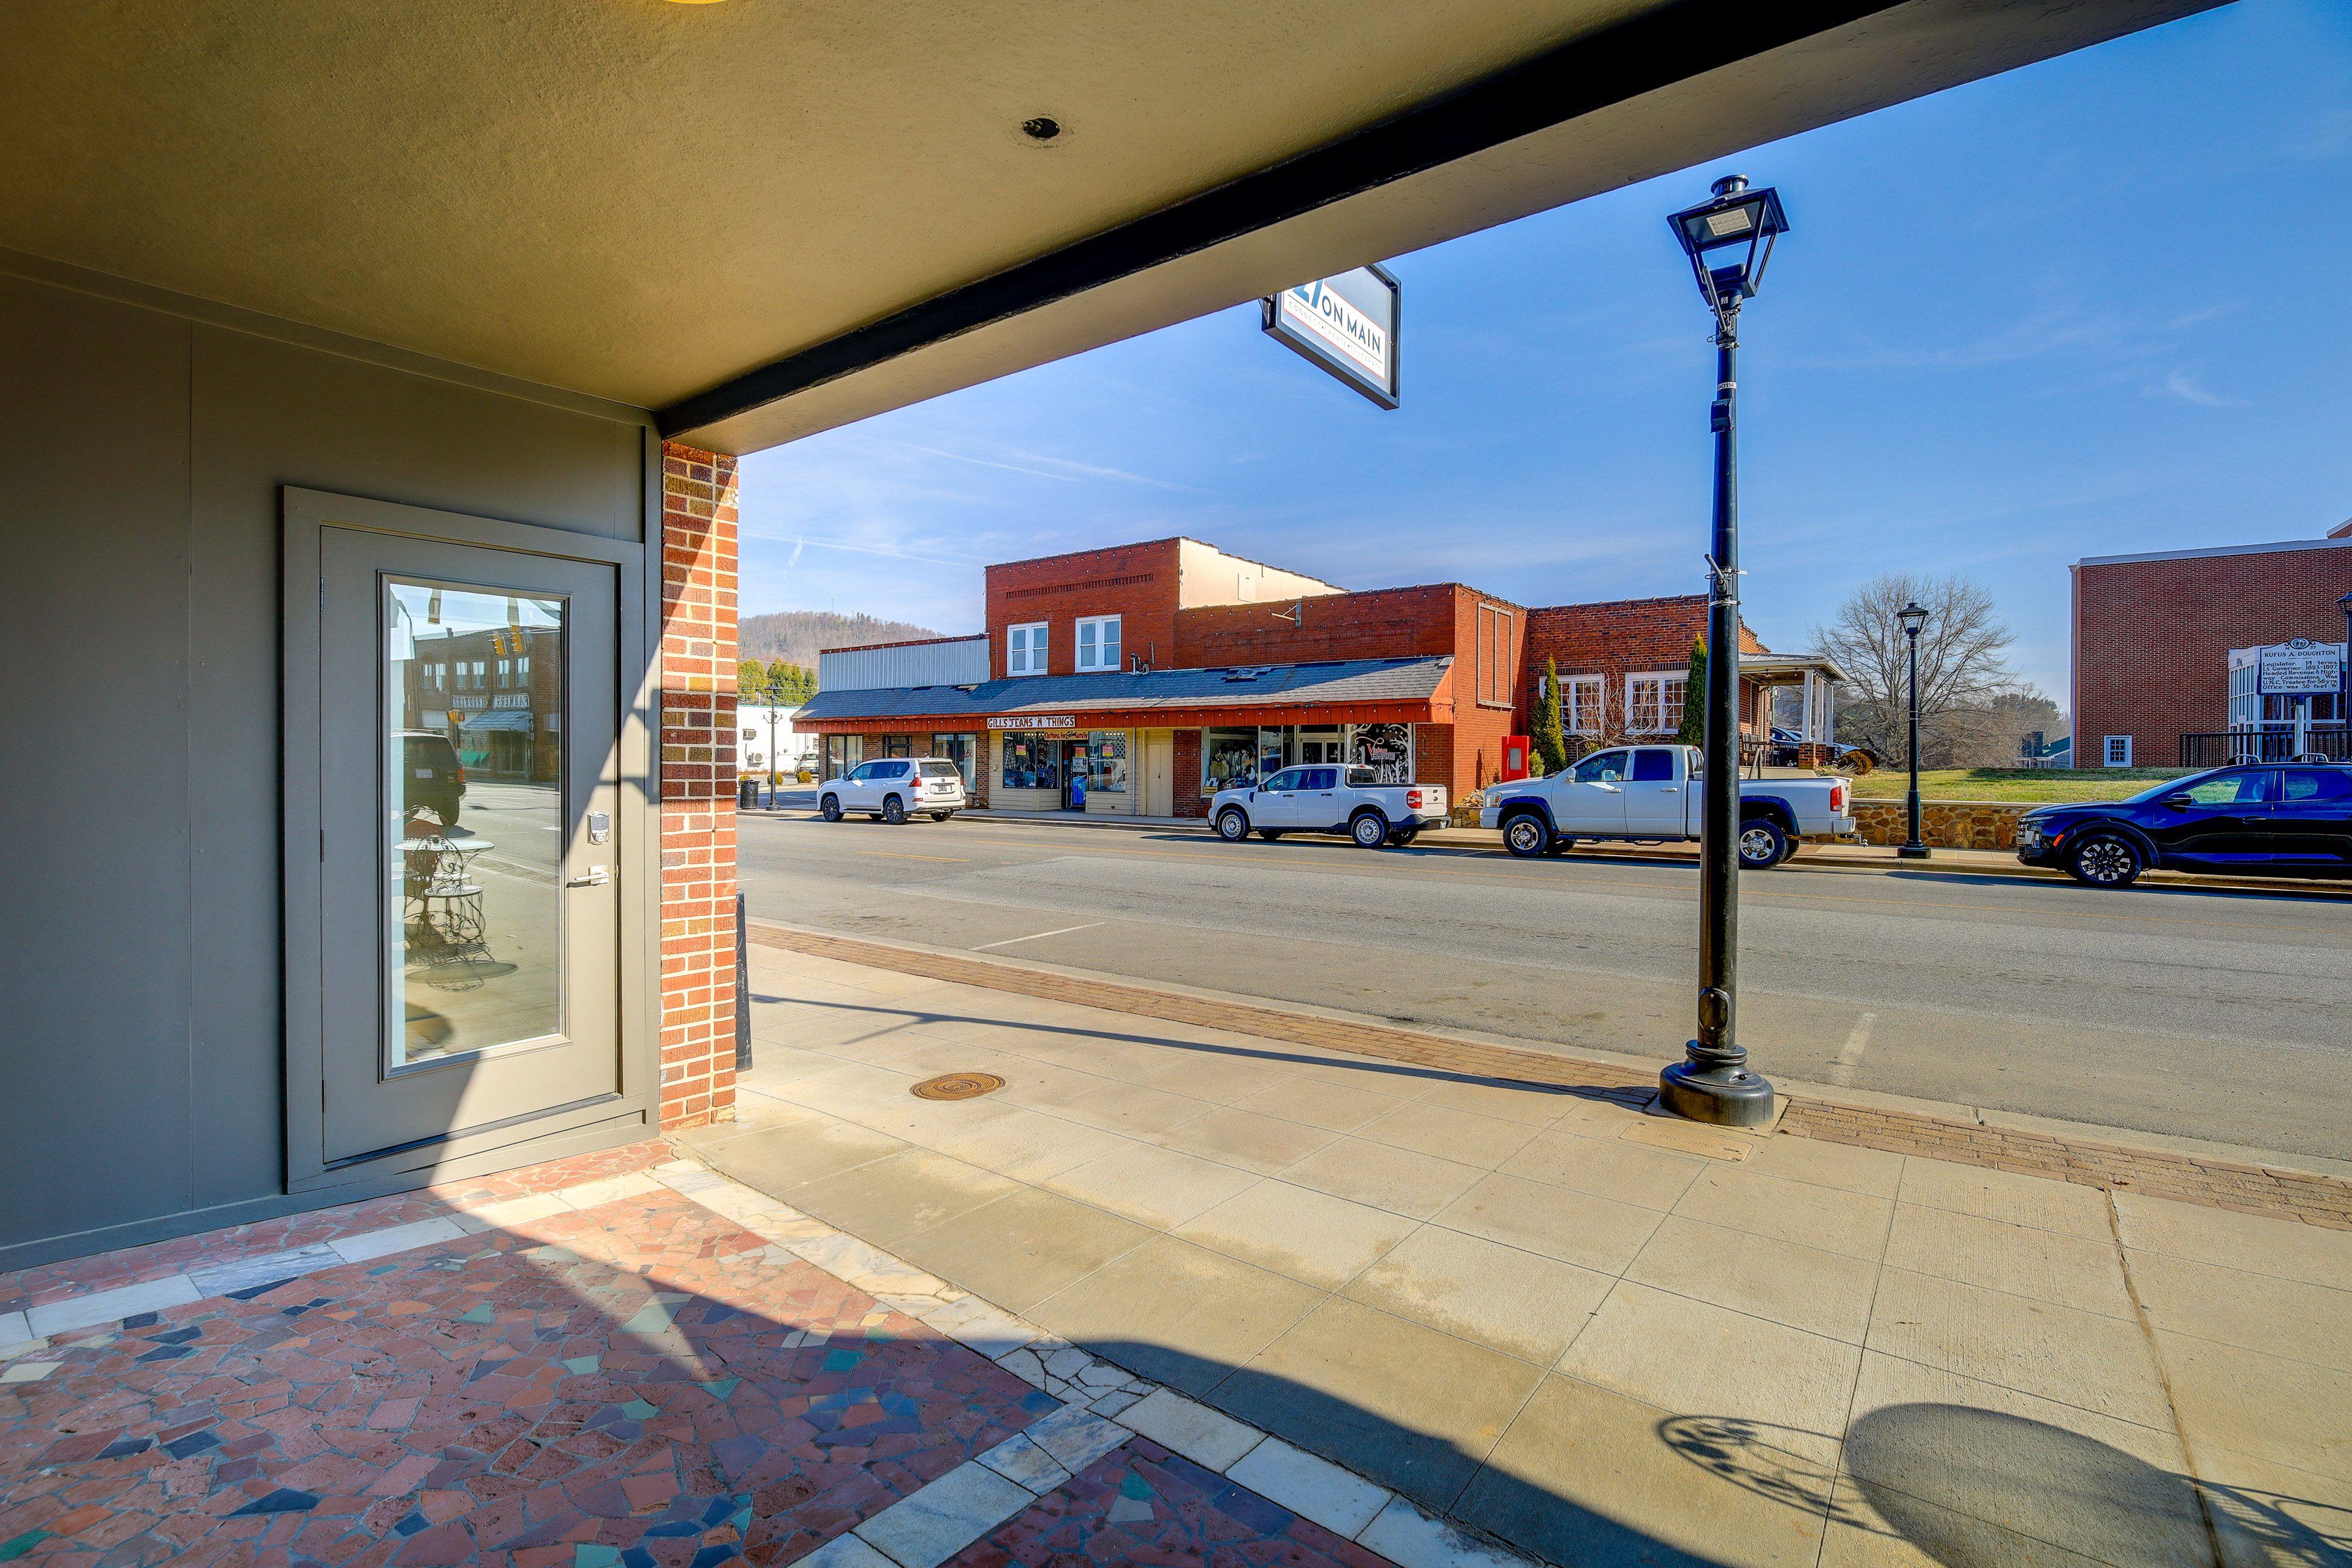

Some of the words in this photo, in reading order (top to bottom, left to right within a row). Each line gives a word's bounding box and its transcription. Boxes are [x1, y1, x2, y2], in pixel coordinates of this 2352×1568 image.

[1289, 301, 1321, 328] CONNECT
[1322, 295, 1343, 327] ON
[1348, 312, 1381, 355] MAIN
[988, 718, 1008, 728] GILL'S
[1009, 717, 1033, 728] JEANS
[1683, 1139, 1715, 1148] LIGHTING
